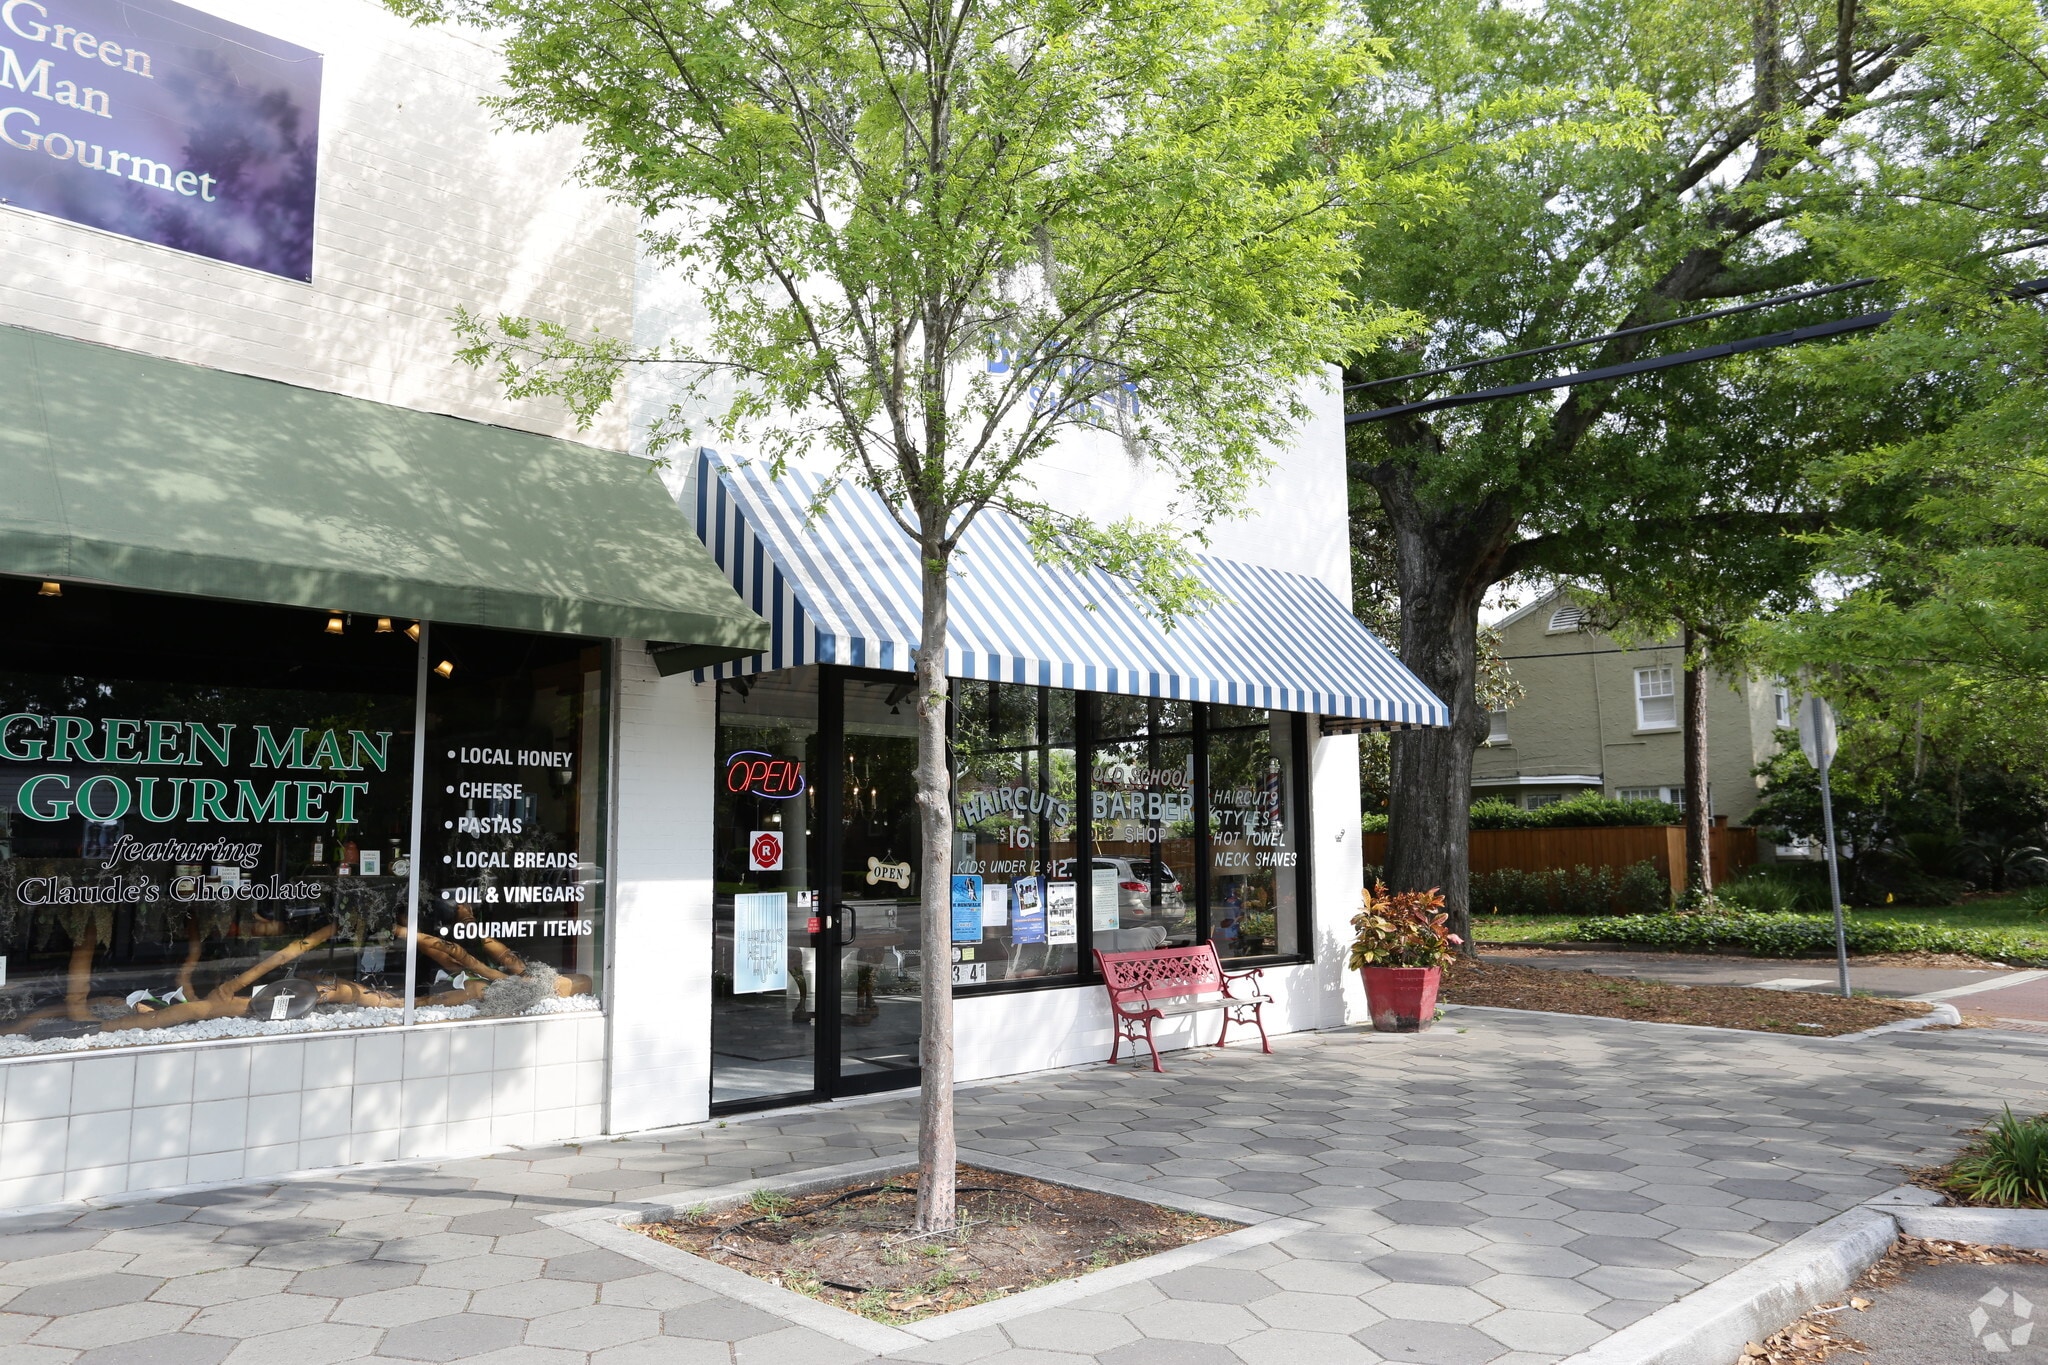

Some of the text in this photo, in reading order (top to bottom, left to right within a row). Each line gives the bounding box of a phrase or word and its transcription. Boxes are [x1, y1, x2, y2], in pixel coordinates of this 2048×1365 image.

[2, 0, 154, 79] Green
[0, 46, 112, 119] Man
[0, 107, 216, 202] Gourmet
[0, 713, 392, 772] GREEN MAN
[461, 747, 573, 768] LOCAL HONEY
[727, 761, 801, 792] OPEN
[1092, 766, 1190, 789] OLD SCHOOL
[17, 774, 368, 823] GOURMET
[459, 782, 523, 800] CHEESE
[1214, 790, 1279, 806] HAIRCUTS
[961, 786, 1070, 828] HAIRCUTS
[1092, 790, 1194, 820] BARBER
[457, 817, 523, 834] PASTAS
[1214, 809, 1270, 826] STYLES
[998, 824, 1035, 850] $16.
[1124, 826, 1168, 844] SHOP
[1213, 831, 1286, 847] HOT TOWEL
[102, 834, 262, 868] featuring
[456, 851, 578, 868] LOCAL BREADS
[761, 845, 771, 856] R
[1214, 852, 1297, 867] NECK SHAVES
[873, 865, 905, 881] OPEN
[956, 860, 986, 874] KIDS
[990, 860, 1026, 873] UNDER
[1029, 860, 1041, 873] 12
[17, 875, 321, 905] Claude's Chocolate
[454, 886, 586, 904] OIL & VINEGARS
[453, 920, 592, 940] GOURMET ITEMS
